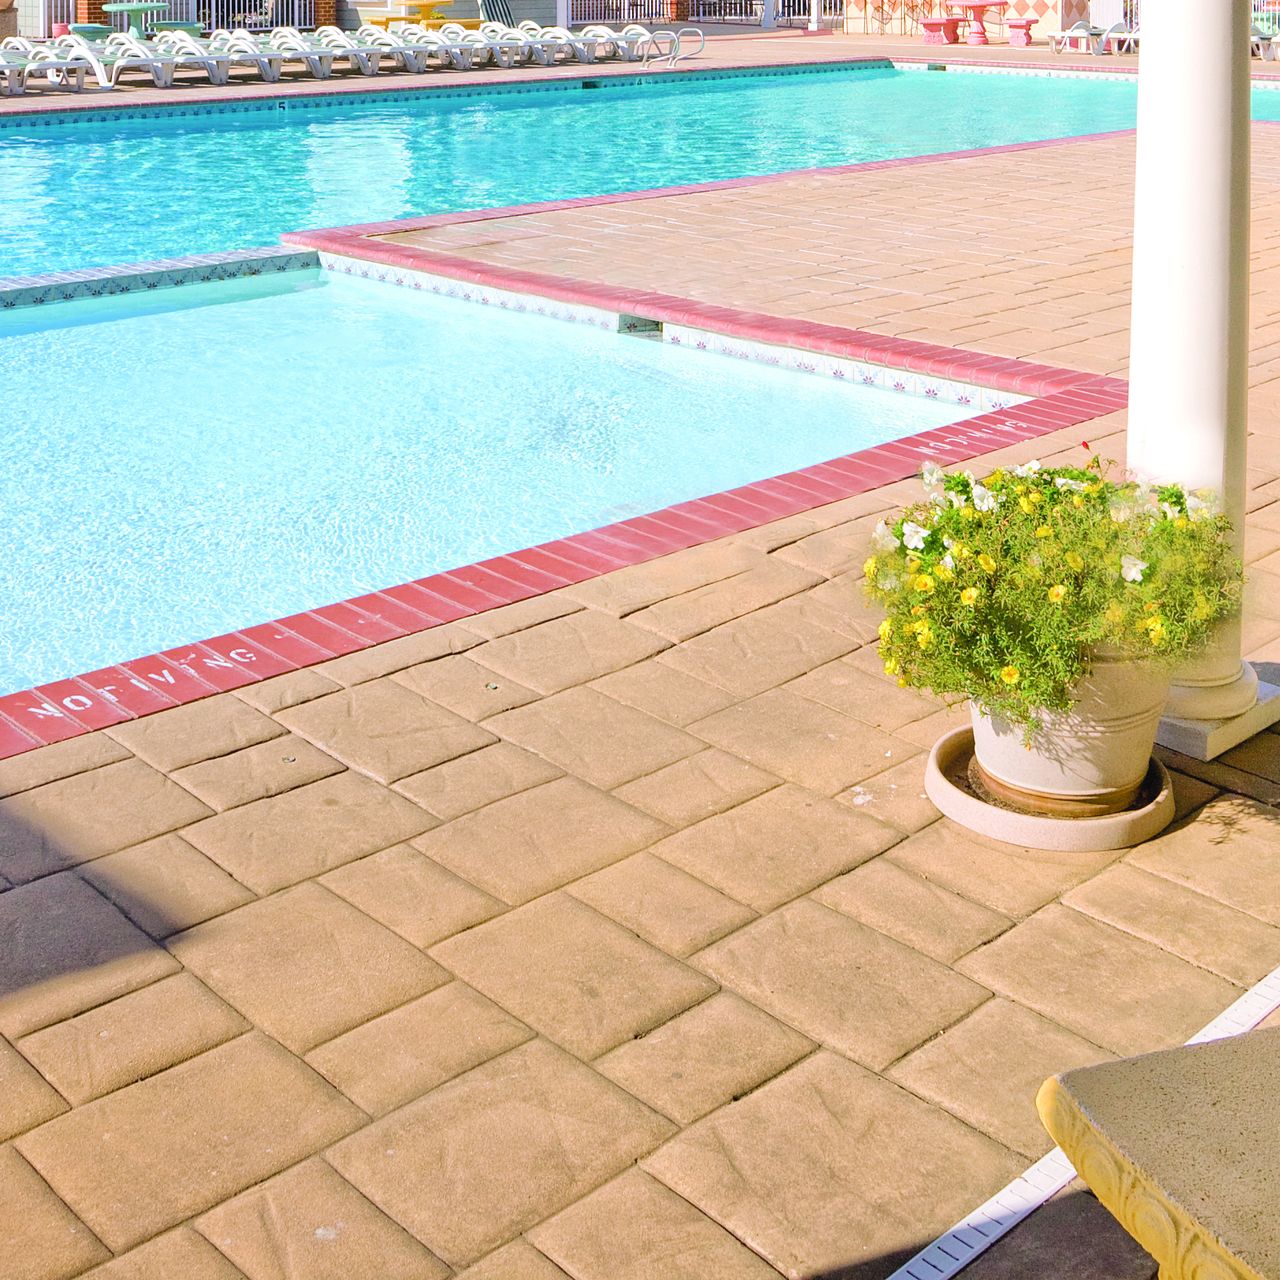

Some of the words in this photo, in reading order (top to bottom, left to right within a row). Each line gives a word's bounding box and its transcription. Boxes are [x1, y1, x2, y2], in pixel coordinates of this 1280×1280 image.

[279, 101, 286, 111] 5
[914, 442, 951, 456] NO
[27, 695, 93, 719] NO
